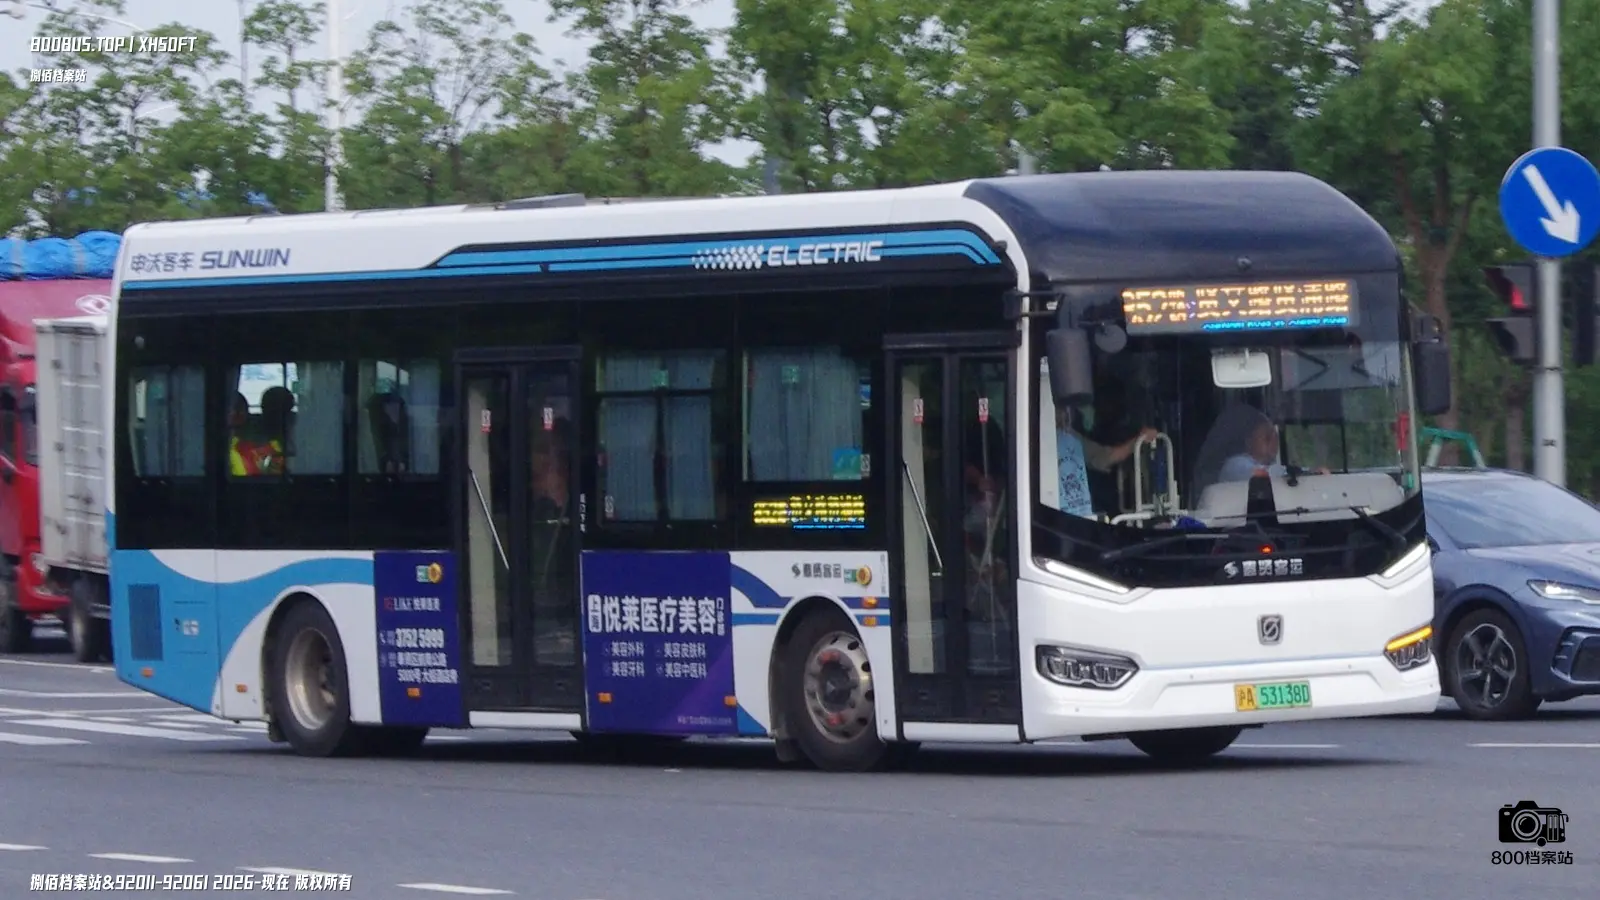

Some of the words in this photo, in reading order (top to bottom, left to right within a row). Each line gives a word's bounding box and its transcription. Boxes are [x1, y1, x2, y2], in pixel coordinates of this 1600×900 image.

[131, 252, 194, 273] 申沃客车
[200, 247, 291, 270] SUNWIN
[767, 240, 884, 267] ELECTRIC
[602, 595, 716, 635] 悦莱医疗美容
[611, 641, 645, 657] 美容外科
[664, 642, 706, 658] 美容皮肤科
[611, 661, 645, 677] 美容牙科
[665, 662, 707, 678] 美容中医科
